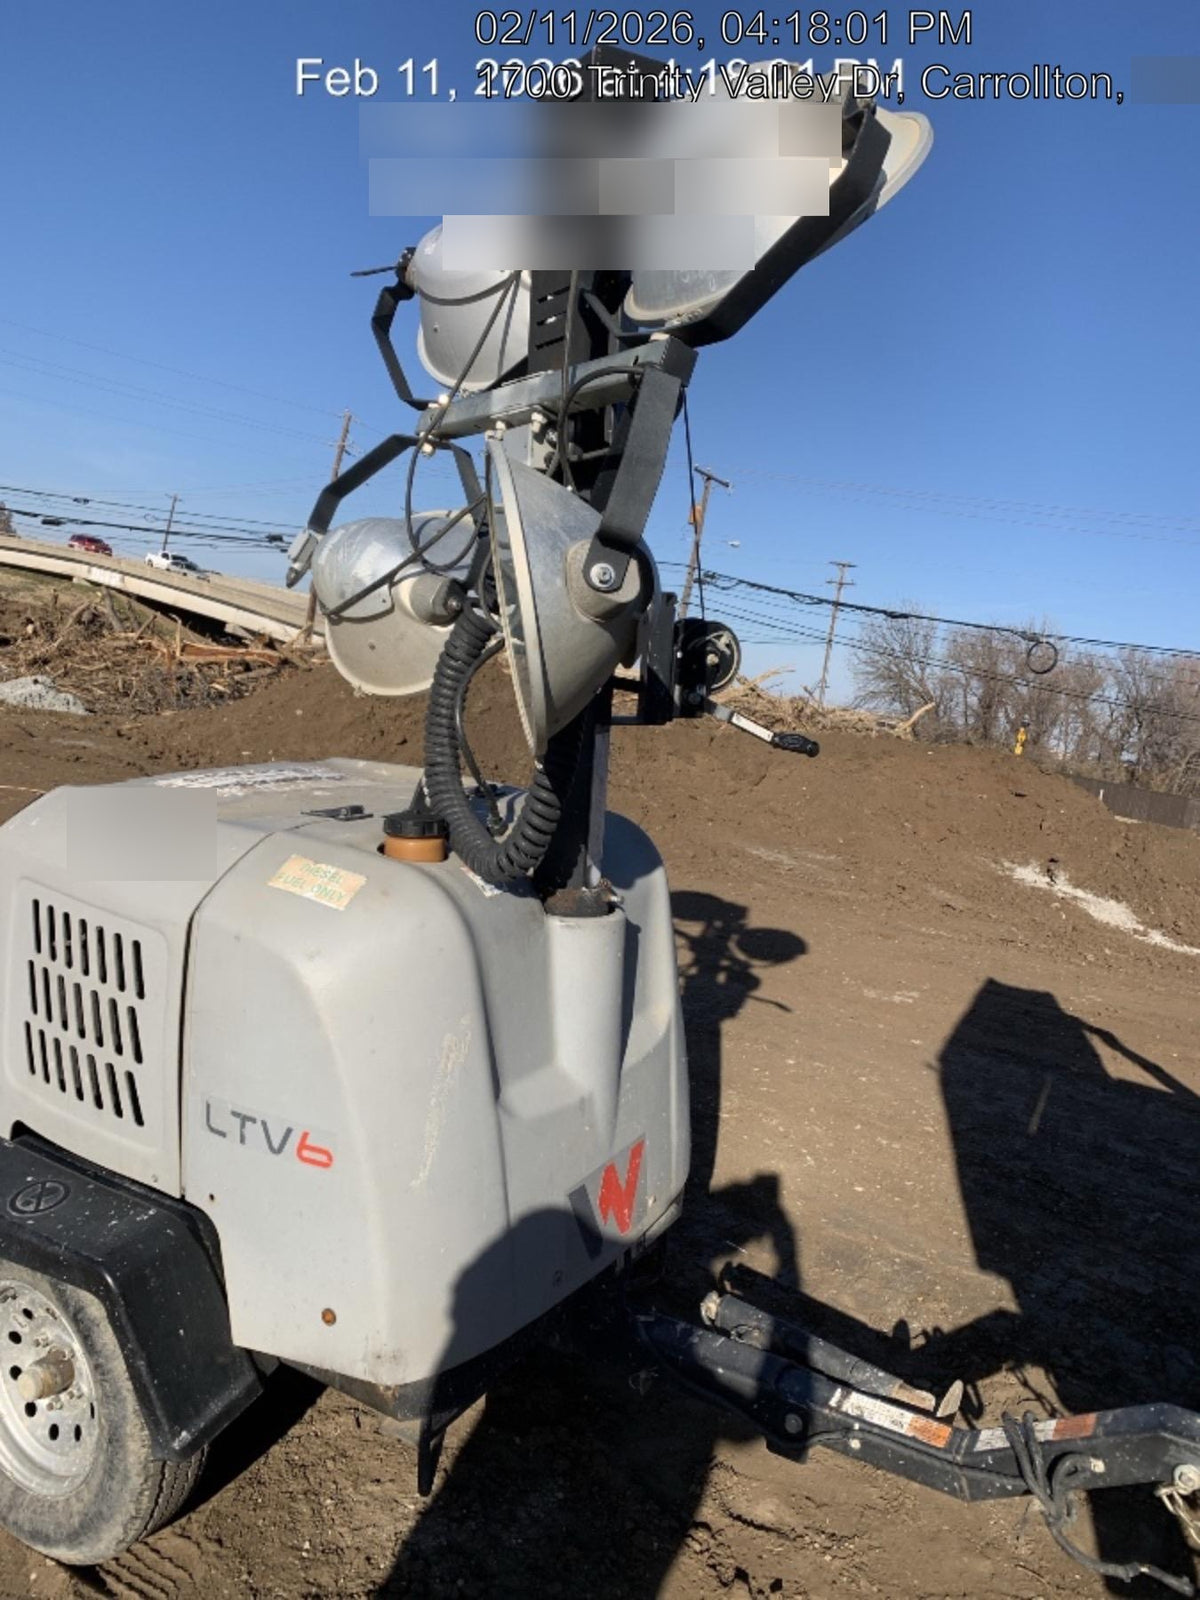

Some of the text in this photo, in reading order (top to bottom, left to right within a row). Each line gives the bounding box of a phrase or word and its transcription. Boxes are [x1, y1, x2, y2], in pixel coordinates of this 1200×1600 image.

[277, 872, 347, 902] FUEL ONLY
[299, 863, 343, 885] DIESEL
[205, 1100, 334, 1169] LTV6
